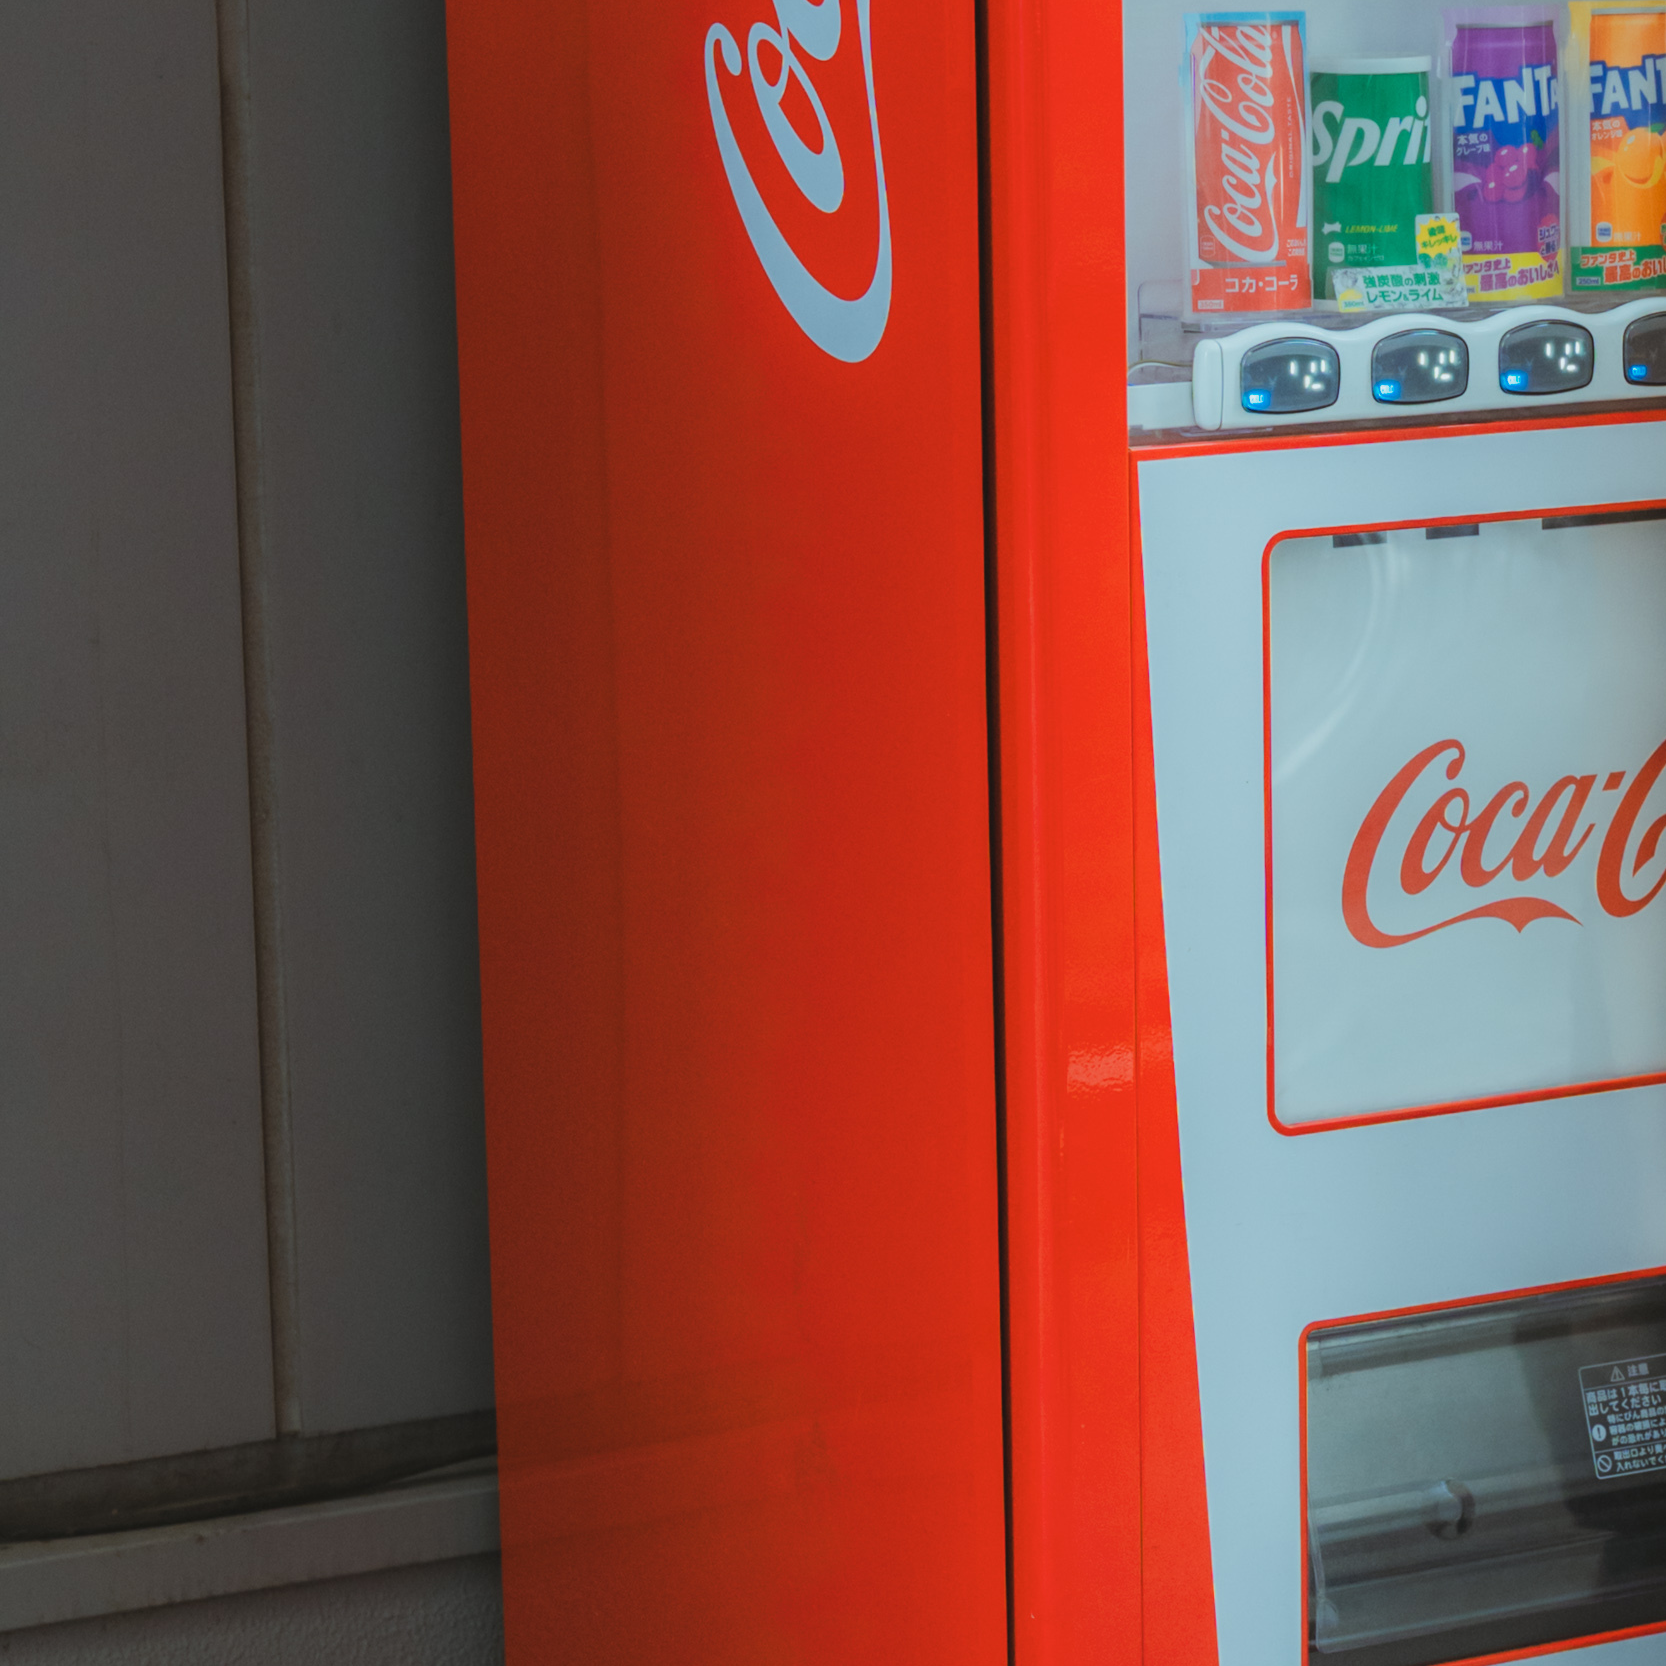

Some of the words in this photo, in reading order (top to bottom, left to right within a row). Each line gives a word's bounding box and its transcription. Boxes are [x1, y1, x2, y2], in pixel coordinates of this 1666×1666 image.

[1592, 120, 1621, 131] 本気の
[1200, 25, 1279, 263] Coca-Cola
[1312, 95, 1431, 183] Spri
[1456, 133, 1488, 145] 本気の
[1456, 144, 1491, 156] グレープ味
[1345, 224, 1398, 233] LEMON-LIME
[1347, 244, 1379, 254] 無果汁
[1473, 241, 1503, 251] 無果汁
[1581, 249, 1635, 268] ファンタ史上
[1225, 274, 1299, 293] コカ・コーラ
[1362, 272, 1441, 289] 強炭酸の刺激
[1366, 288, 1444, 303] レモン&ライム
[1627, 1363, 1649, 1377] 注意
[1589, 1394, 1662, 1417] 出してください
